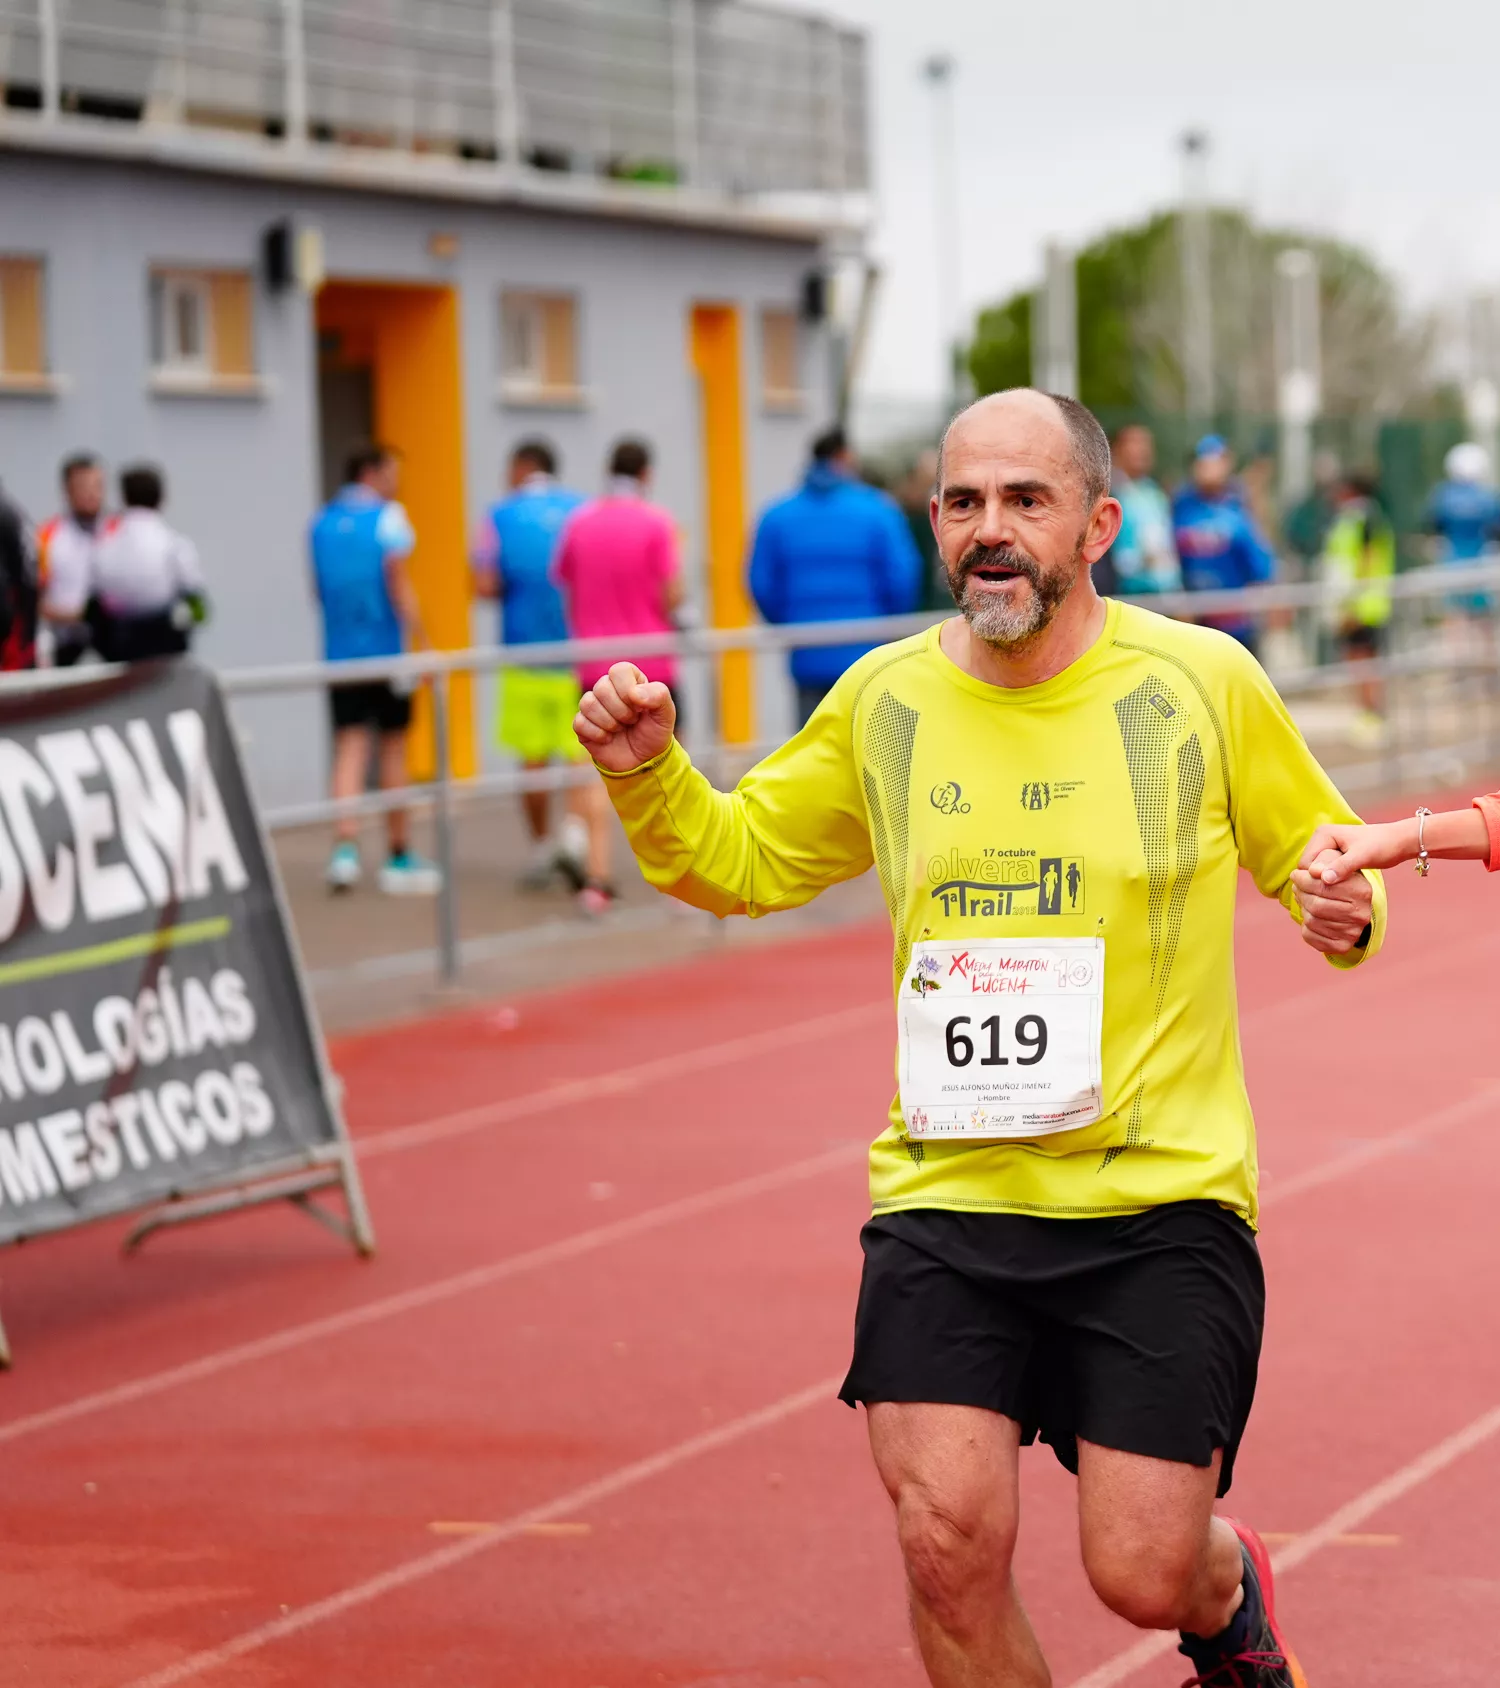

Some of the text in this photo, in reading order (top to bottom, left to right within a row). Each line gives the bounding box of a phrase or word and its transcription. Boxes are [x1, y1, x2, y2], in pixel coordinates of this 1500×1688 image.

[1154, 697, 1172, 715] 42K
[941, 802, 971, 814] CAO
[983, 848, 1036, 857] 17 octubre
[958, 884, 1013, 917] Trail
[1013, 905, 1037, 916] 2015
[972, 975, 1035, 995] LUCENA
[945, 1014, 1048, 1067] 619
[960, 1083, 991, 1091] ALFONSO
[992, 1081, 1020, 1091] MUÑOZ
[1022, 1104, 1094, 1120] mediamaratonlucena.com
[0, 1061, 274, 1208] MESTICOS
